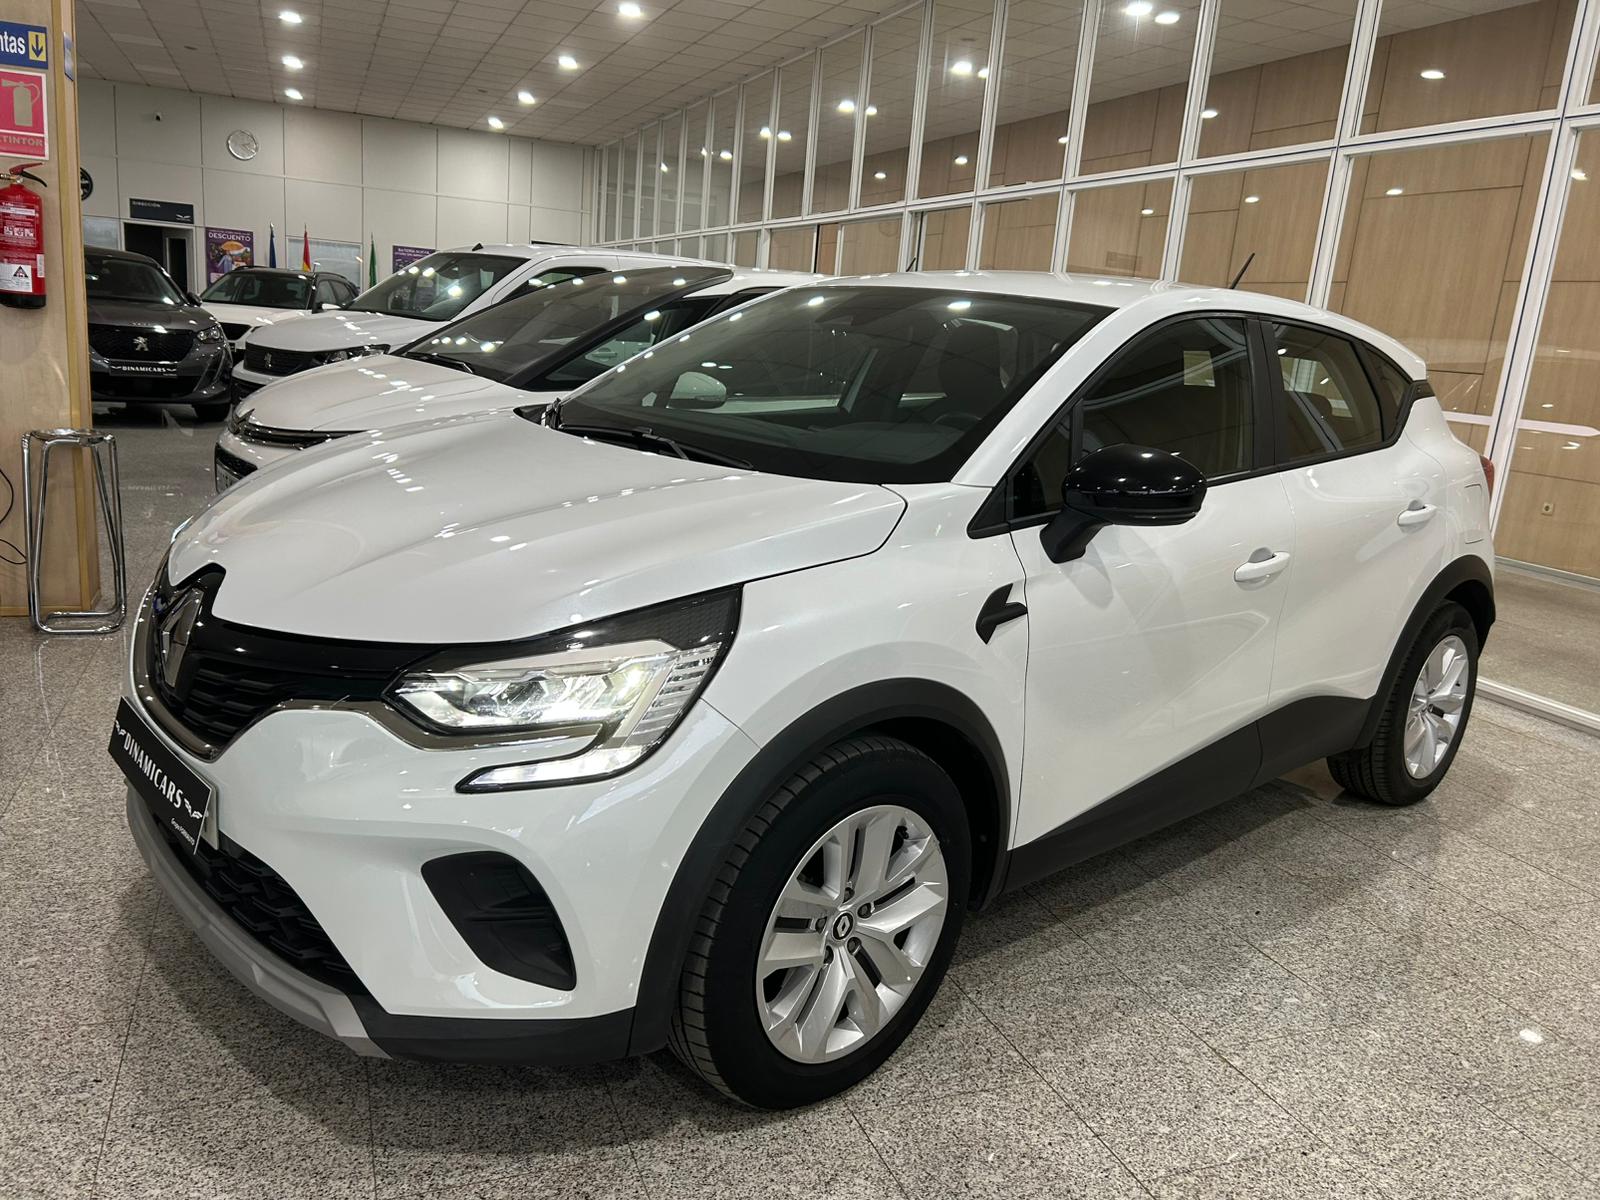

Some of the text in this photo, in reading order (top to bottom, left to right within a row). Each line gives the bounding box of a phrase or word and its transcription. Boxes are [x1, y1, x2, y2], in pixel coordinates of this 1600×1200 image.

[0, 135, 44, 147] TINTOR
[208, 232, 251, 241] DESCUENTO
[124, 733, 183, 808] DINAMICARS
